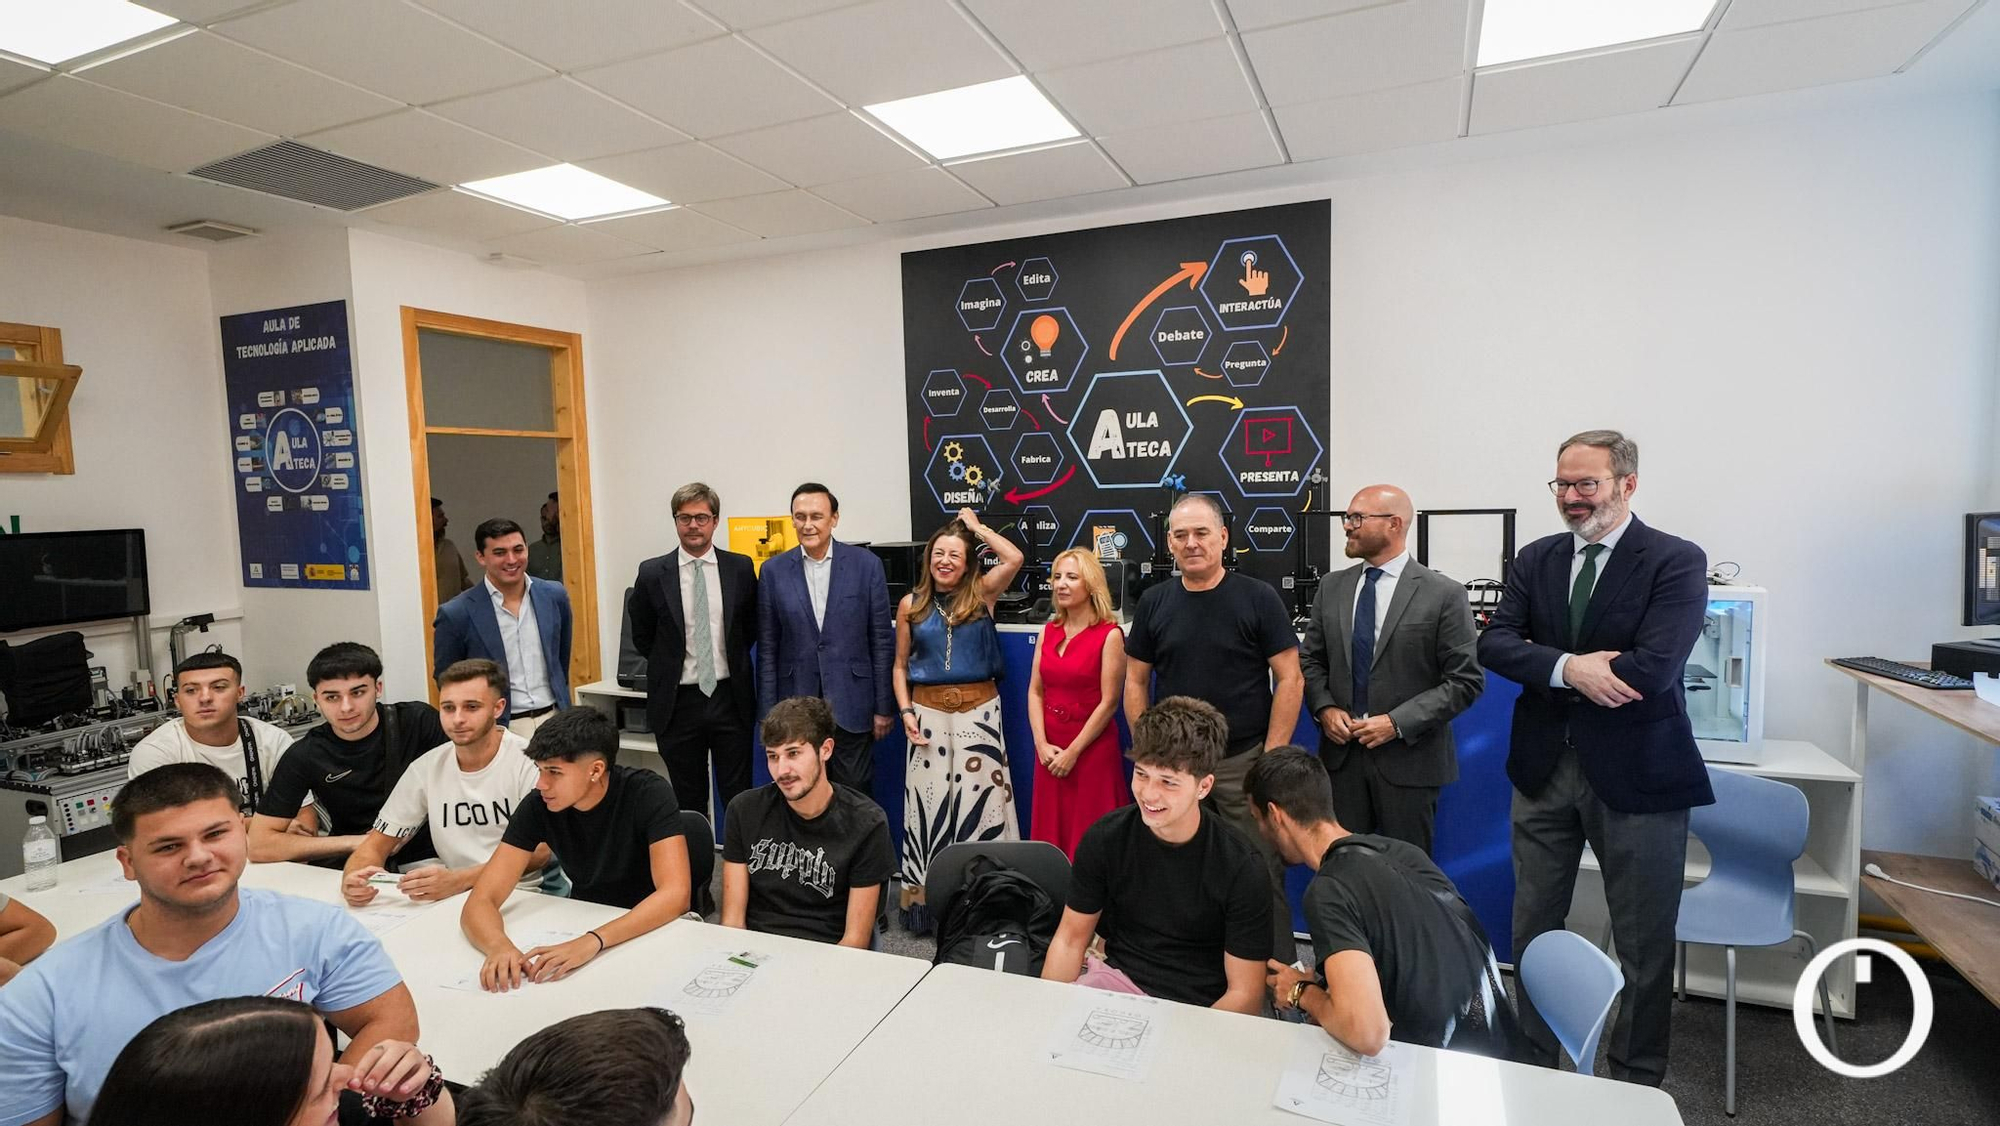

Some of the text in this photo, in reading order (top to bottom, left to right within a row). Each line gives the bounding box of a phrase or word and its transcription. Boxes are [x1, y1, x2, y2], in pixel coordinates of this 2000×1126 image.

[1023, 273, 1051, 285] Edita
[961, 297, 1002, 312] Imagina
[1219, 296, 1282, 313] INTERACTÚA
[263, 316, 300, 333] AULA DE
[1158, 329, 1203, 341] Debate
[236, 336, 336, 359] TECNOLOGÍA APLICADA
[1225, 359, 1267, 371] Pregunta
[1026, 369, 1058, 382] CREA
[928, 388, 960, 397] Inventa
[983, 405, 1016, 414] Desarrolla
[1021, 454, 1051, 464] Fabrica
[1240, 470, 1299, 484] PRESENTA
[1248, 525, 1292, 536] Comparte
[443, 798, 512, 828] ICON
